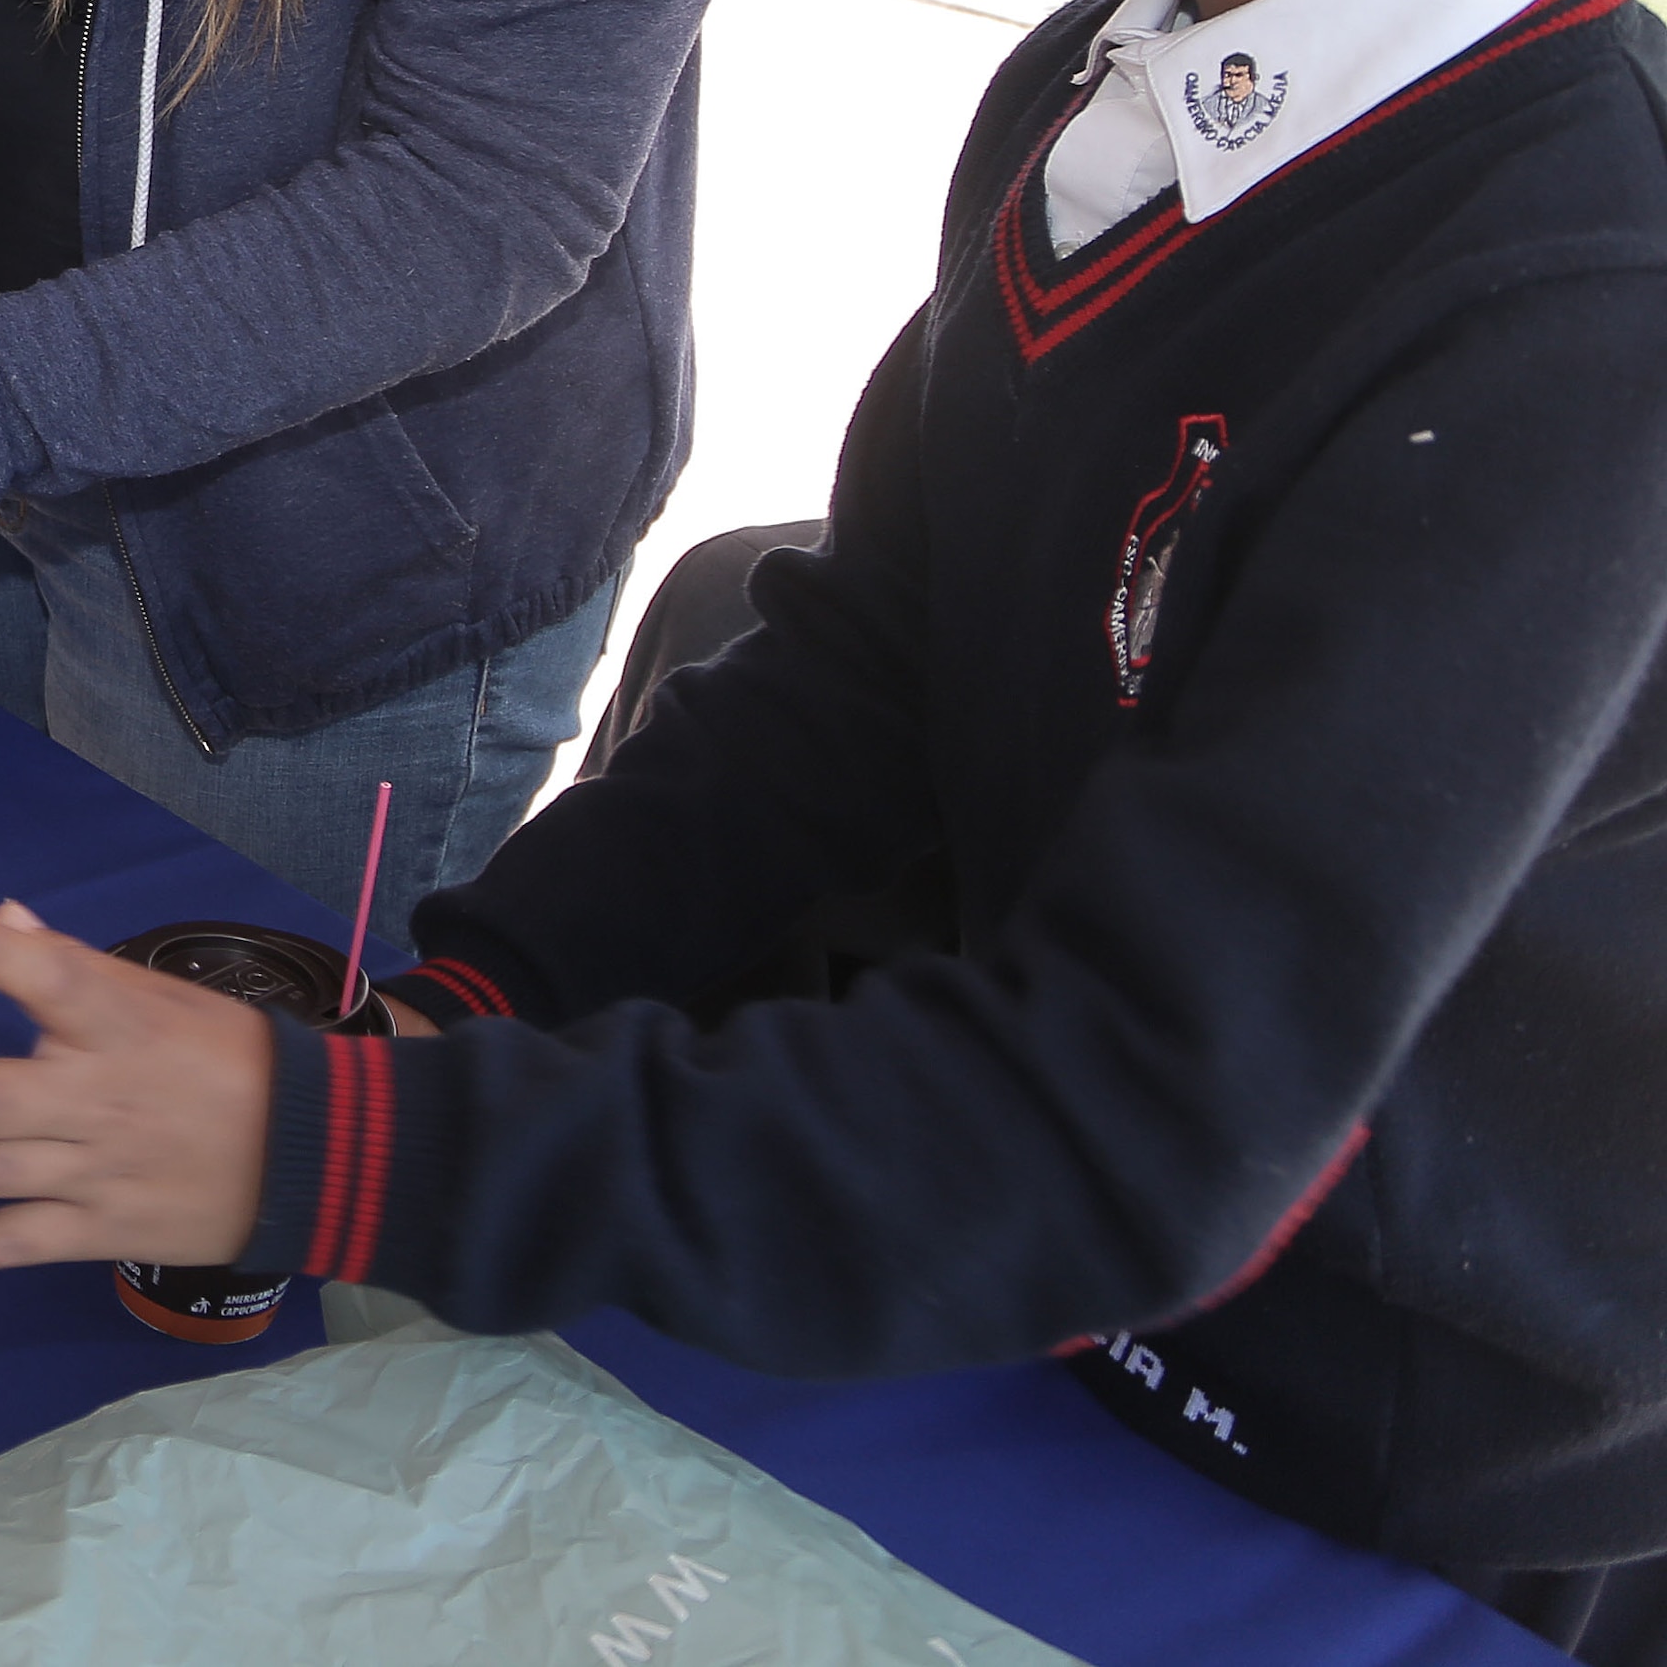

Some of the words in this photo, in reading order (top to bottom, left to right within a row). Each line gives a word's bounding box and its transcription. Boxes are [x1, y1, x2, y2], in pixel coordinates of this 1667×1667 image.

[1216, 120, 1269, 152] GARCIA
[1089, 1330, 1166, 1391] IA
[1183, 1386, 1249, 1456] M.
